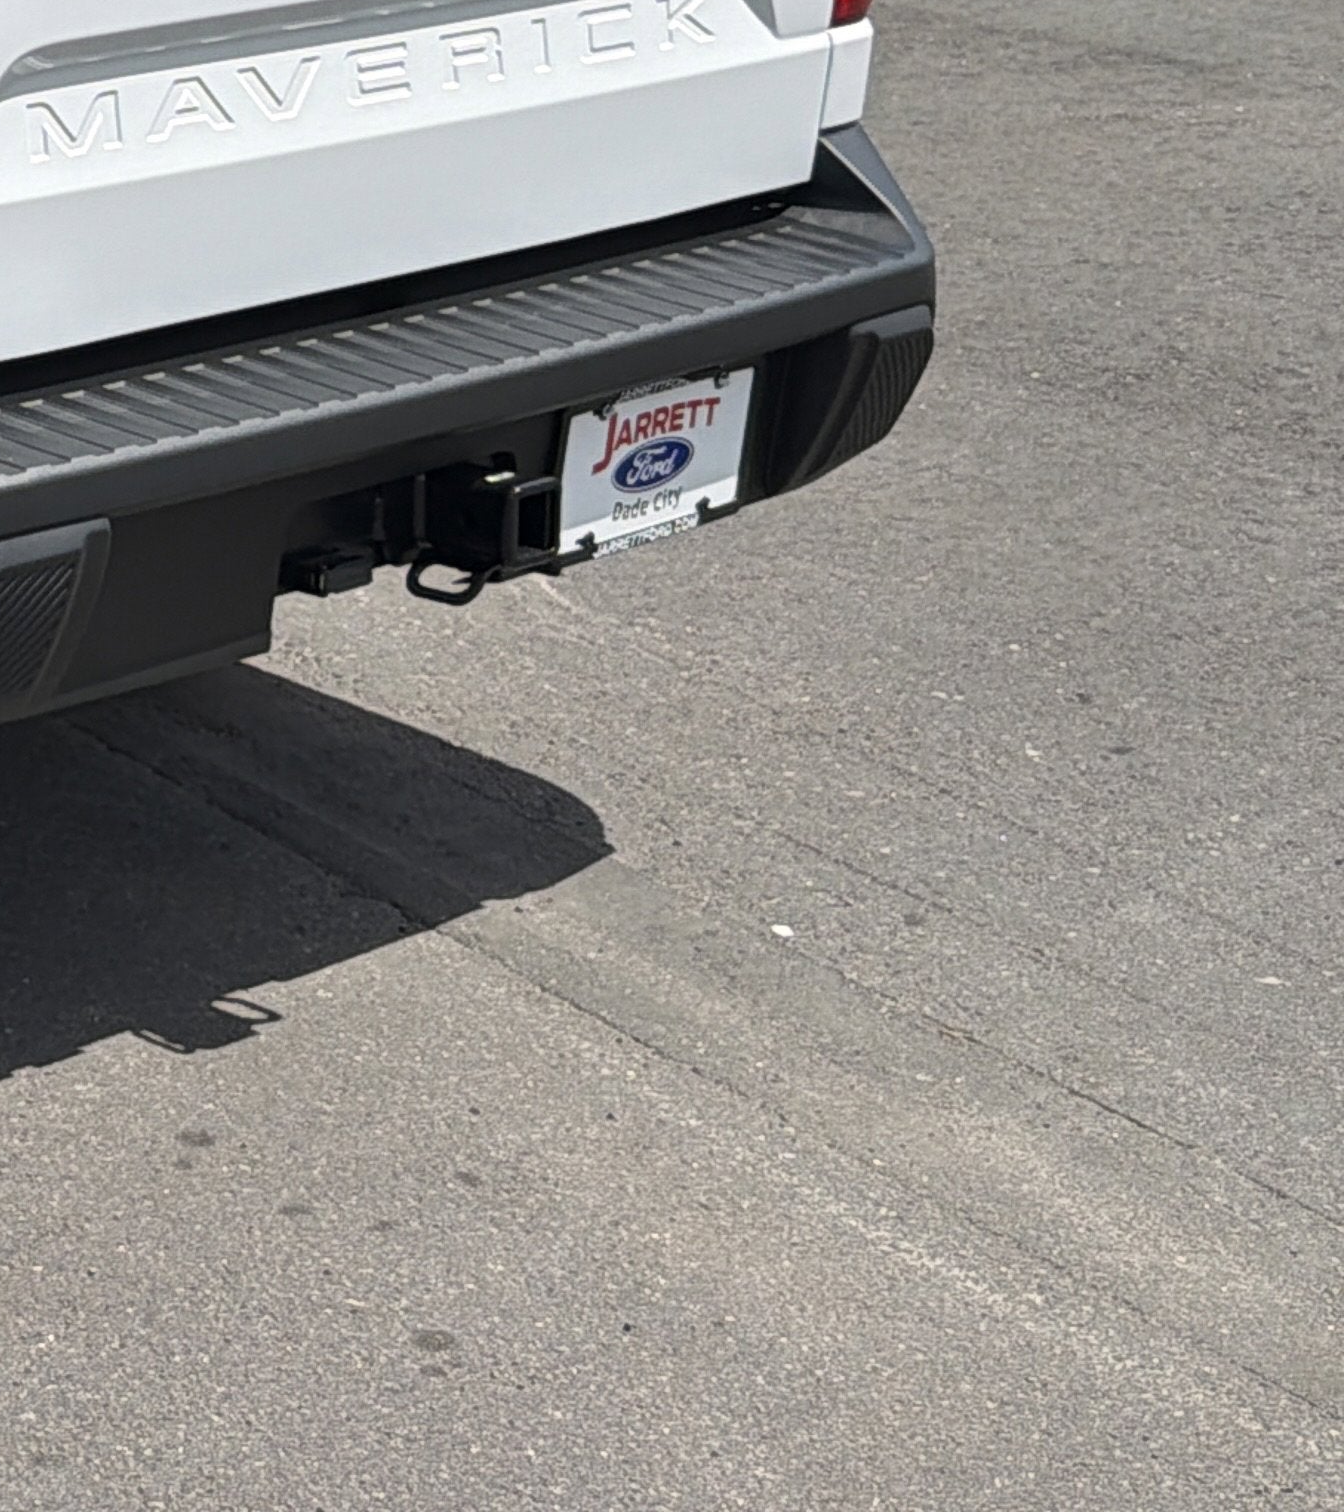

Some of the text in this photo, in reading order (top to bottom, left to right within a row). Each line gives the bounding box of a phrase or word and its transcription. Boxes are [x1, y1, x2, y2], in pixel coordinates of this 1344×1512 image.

[592, 396, 721, 475] JARRETT
[626, 445, 679, 486] Ford
[612, 485, 683, 522] Dade City
